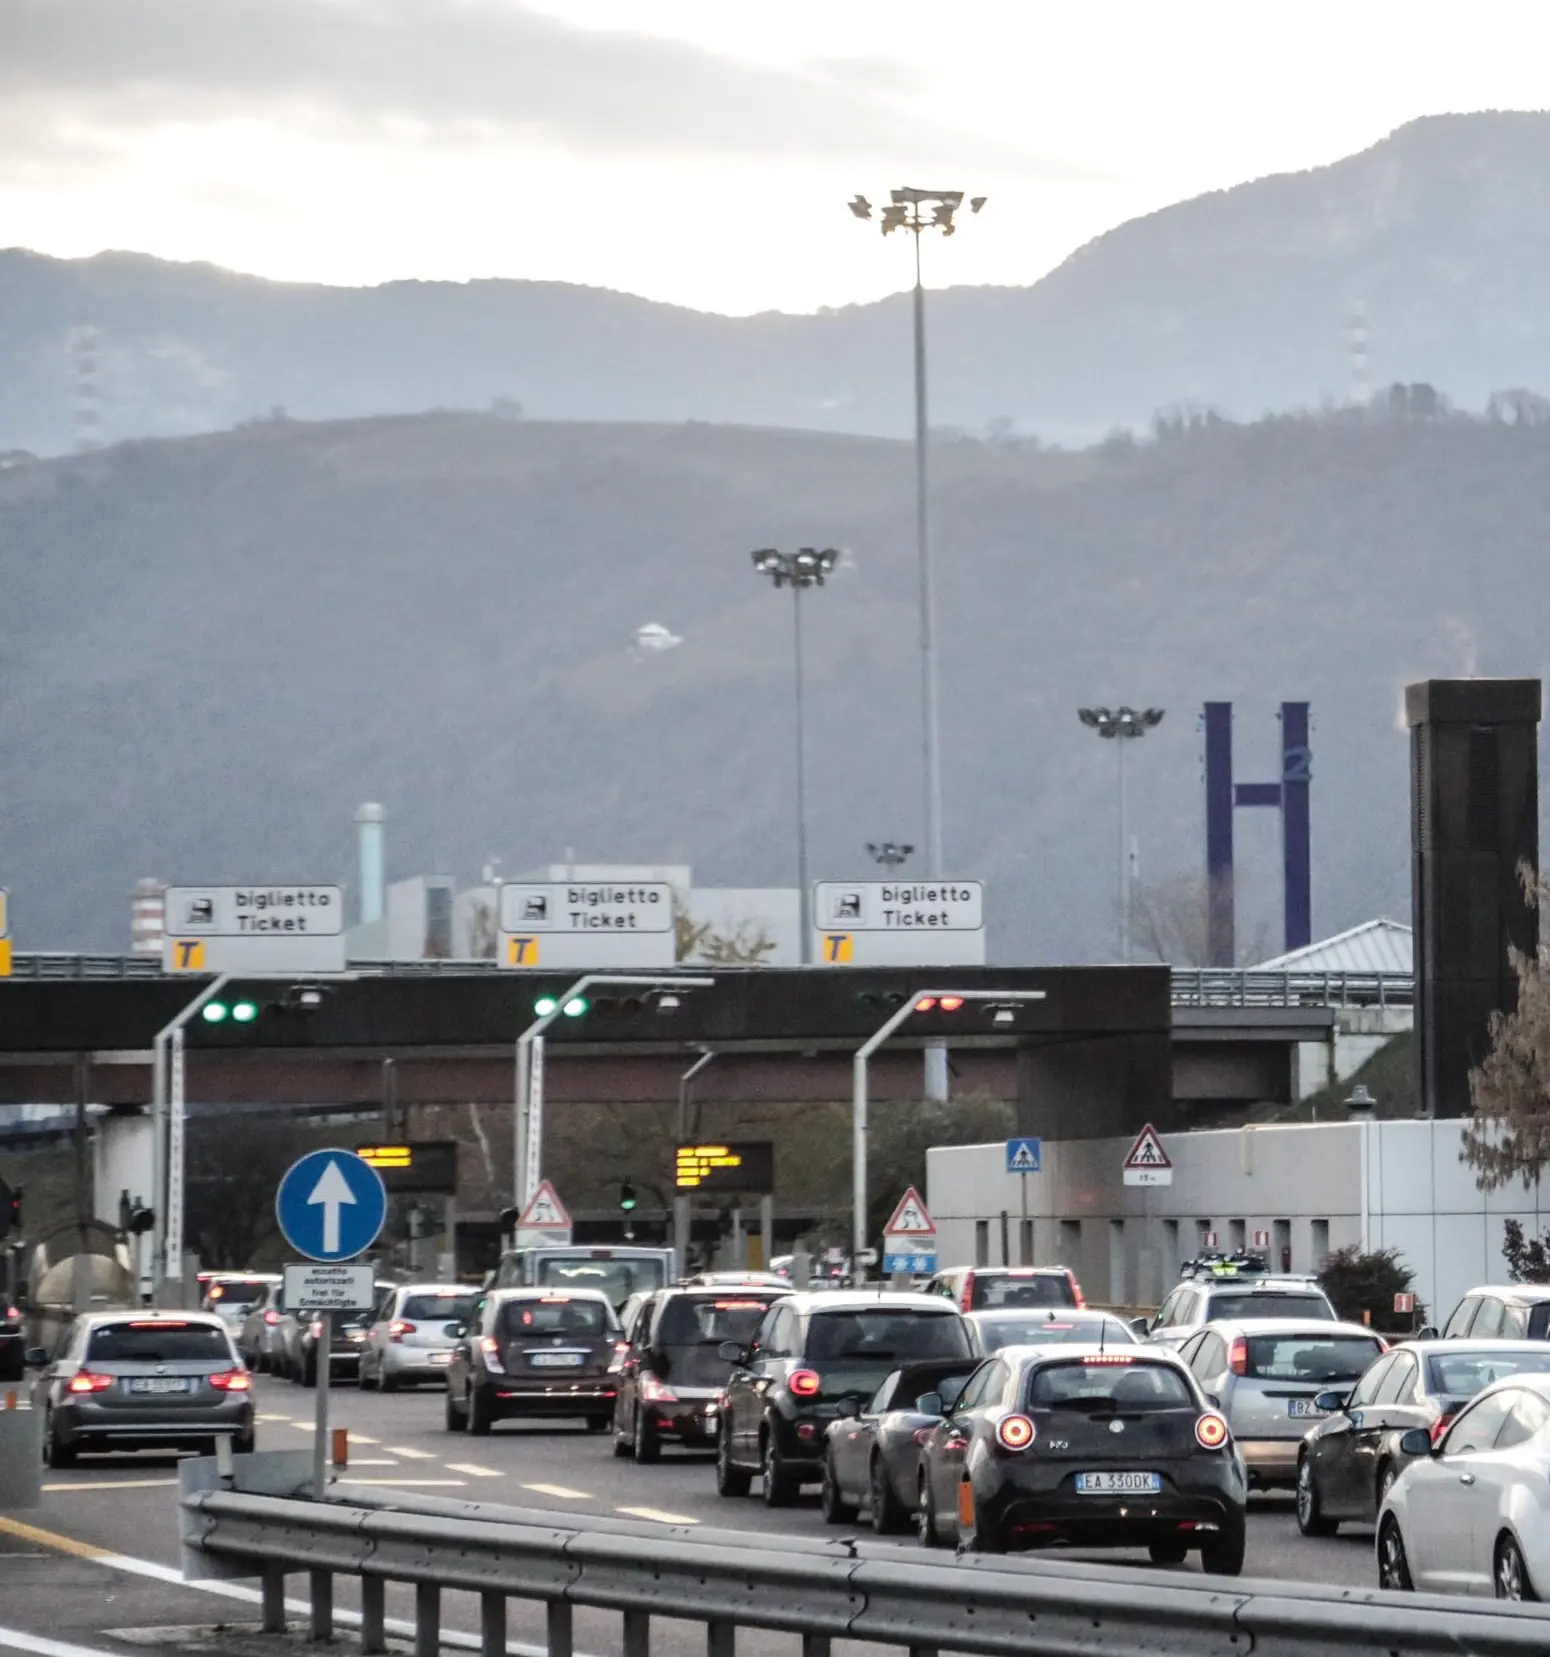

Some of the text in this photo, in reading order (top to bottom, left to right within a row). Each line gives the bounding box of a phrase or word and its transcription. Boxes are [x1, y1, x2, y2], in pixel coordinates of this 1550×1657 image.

[235, 890, 331, 909] biglietto
[567, 887, 659, 906] biglietto
[881, 886, 971, 904] biglietto
[237, 915, 307, 931] Ticket
[569, 912, 636, 928] Ticket
[883, 910, 949, 926] Ticket
[178, 941, 200, 968] T
[512, 938, 533, 964] T
[827, 935, 848, 961] T
[1085, 1474, 1102, 1489] EA
